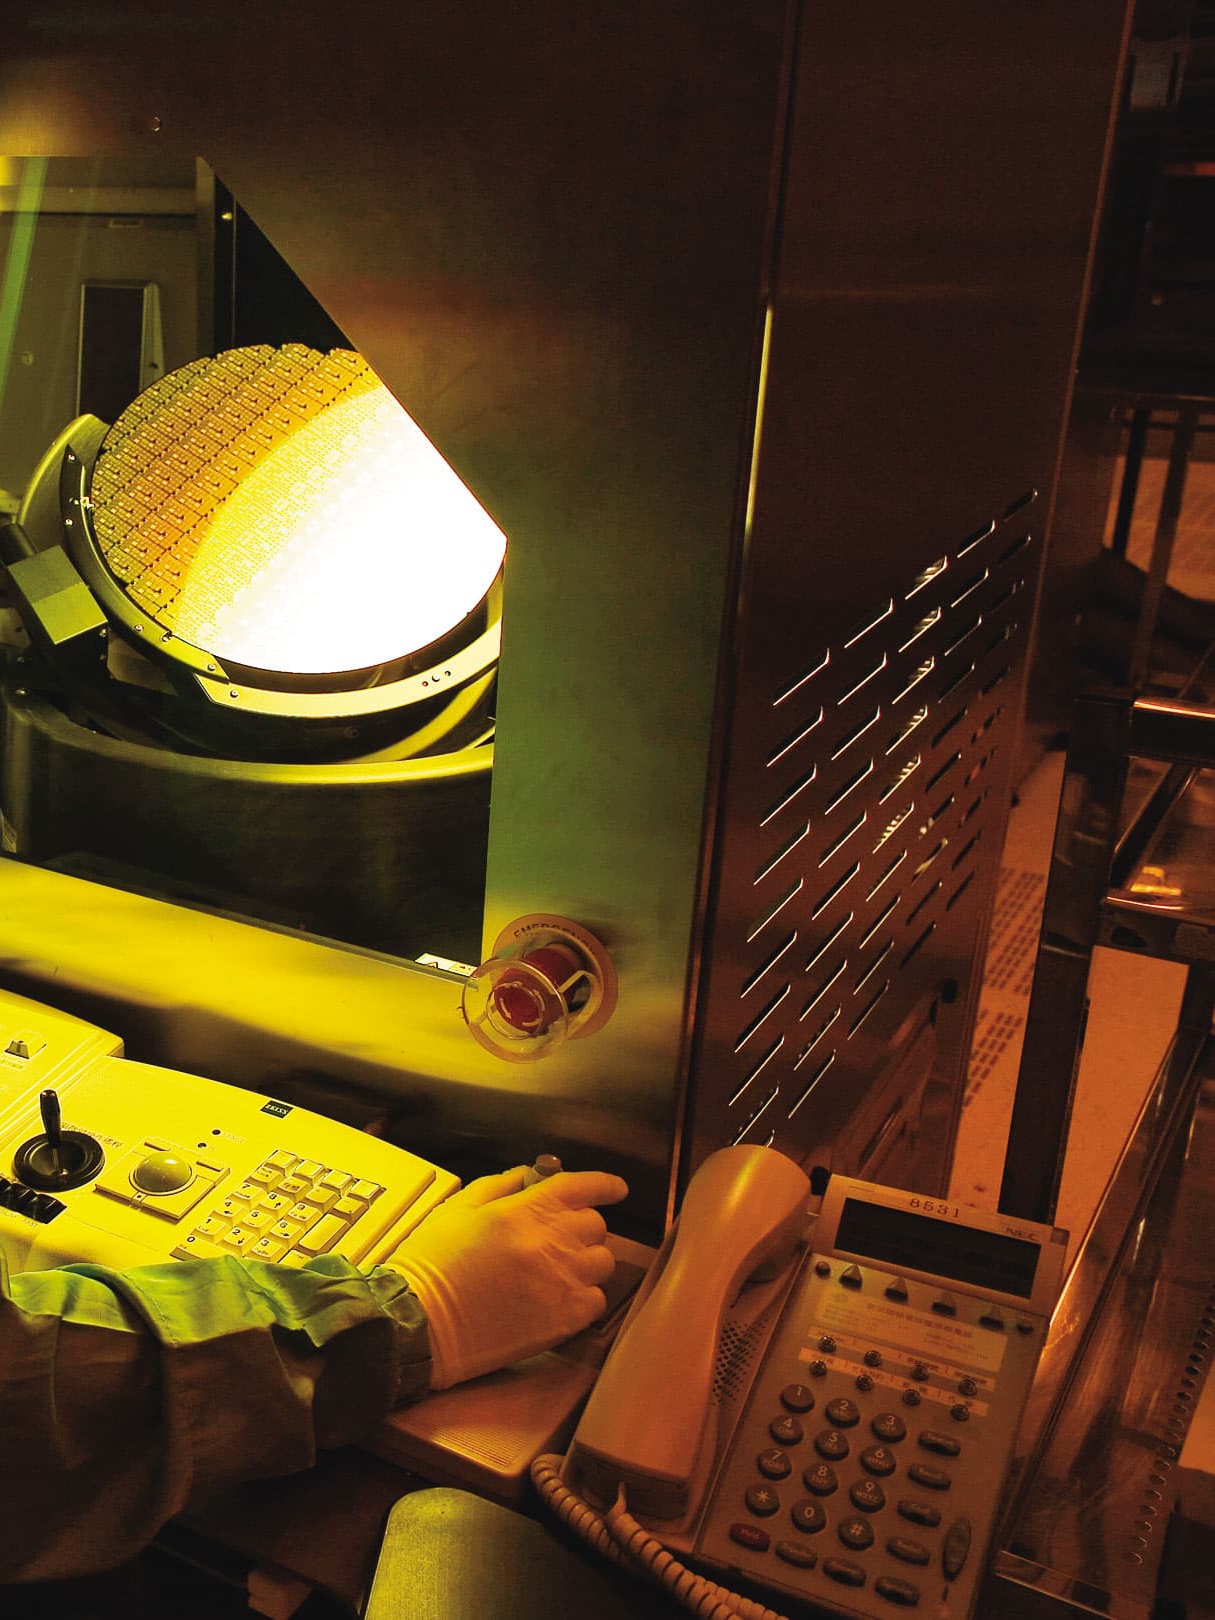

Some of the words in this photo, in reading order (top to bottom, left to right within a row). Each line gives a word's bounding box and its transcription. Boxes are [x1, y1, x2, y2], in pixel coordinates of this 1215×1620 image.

[297, 1203, 306, 1211] 9
[909, 1197, 961, 1218] 8531
[279, 1221, 288, 1229] 6
[1005, 1227, 1042, 1242] NEC
[232, 1228, 241, 1236] 2
[260, 1239, 269, 1247] 3
[840, 1400, 849, 1410] 2
[886, 1415, 896, 1425] 3
[784, 1417, 793, 1428] 4
[830, 1432, 839, 1442] 5
[874, 1448, 884, 1458] 6
[772, 1450, 782, 1460] 7
[817, 1464, 827, 1477] 8
[864, 1481, 875, 1491] 9
[804, 1507, 814, 1518] 0
[850, 1523, 863, 1536] #
